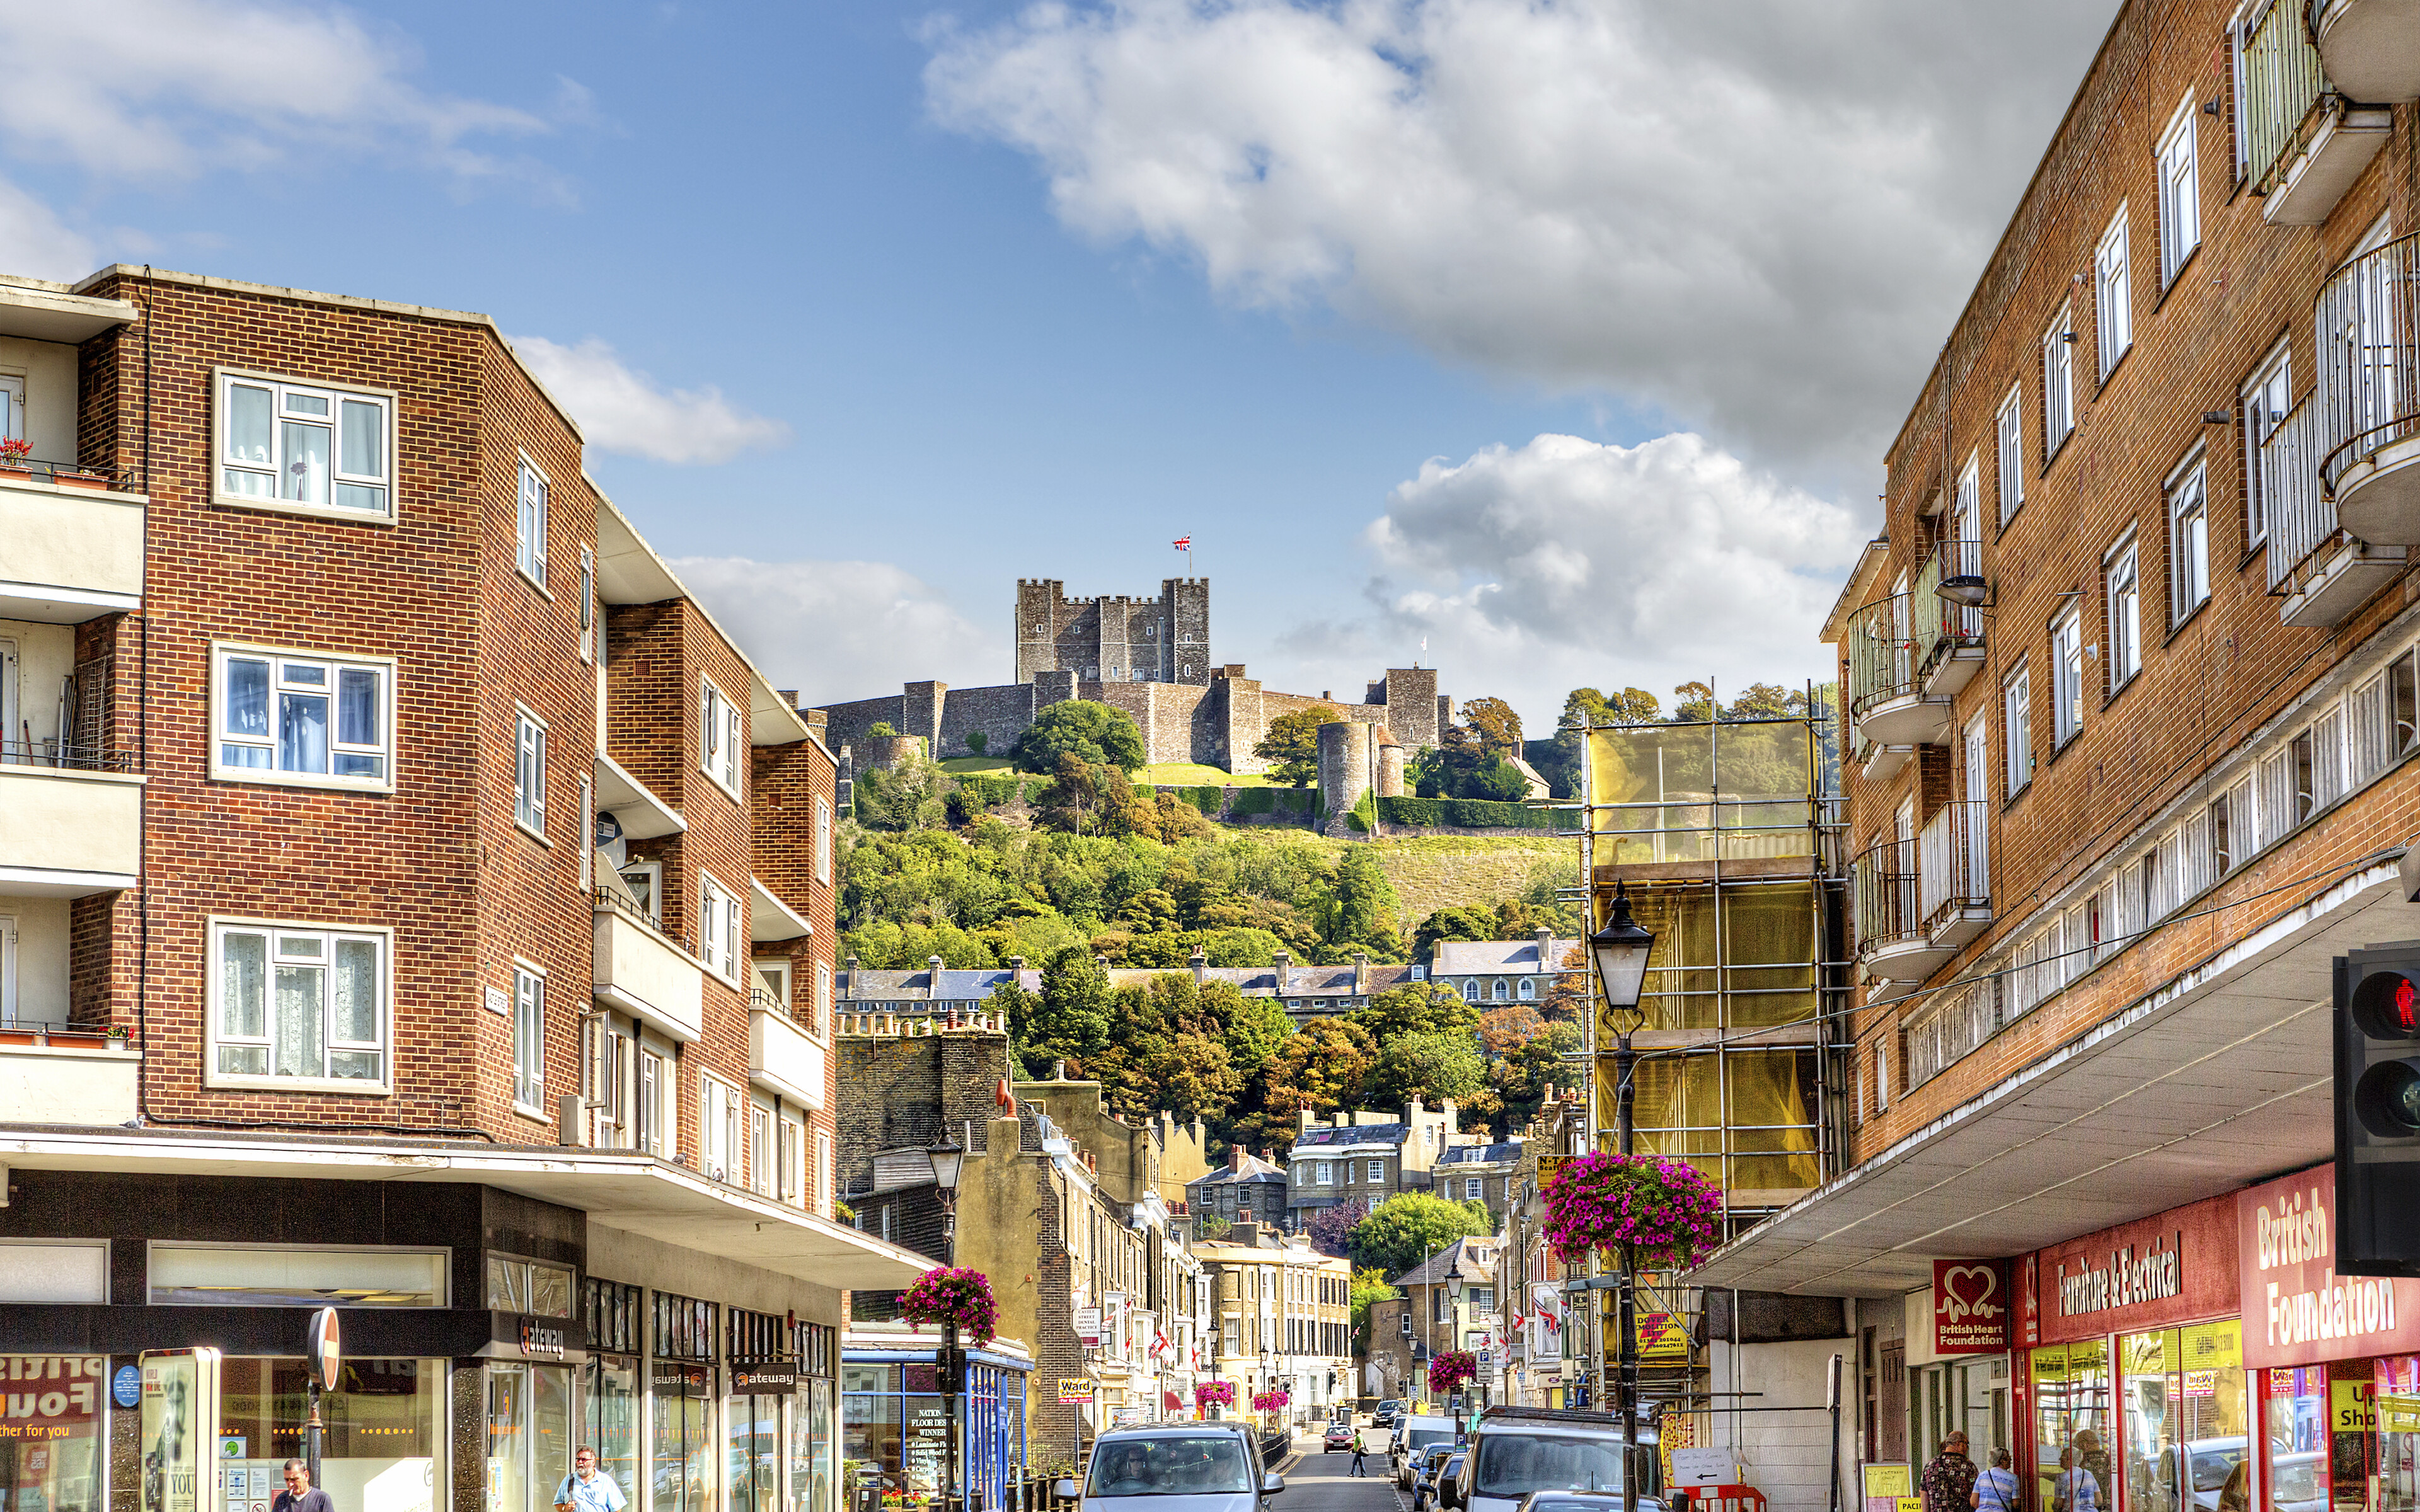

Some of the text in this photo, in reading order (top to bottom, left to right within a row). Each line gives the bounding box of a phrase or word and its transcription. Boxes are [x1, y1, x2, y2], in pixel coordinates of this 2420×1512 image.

[2257, 1187, 2327, 1270] British
[2058, 1230, 2181, 1317] Furniture & Electrical
[2267, 1267, 2395, 1346] Foundation
[1940, 1325, 2003, 1334] British Heart
[1940, 1335, 2003, 1345] Foundation
[2273, 1371, 2293, 1381] War
[1061, 1381, 1089, 1390] Ward
[911, 1419, 957, 1427] FLOOR DESN
[26, 1424, 44, 1437] for
[47, 1426, 69, 1440] you
[171, 1474, 194, 1494] YOU
